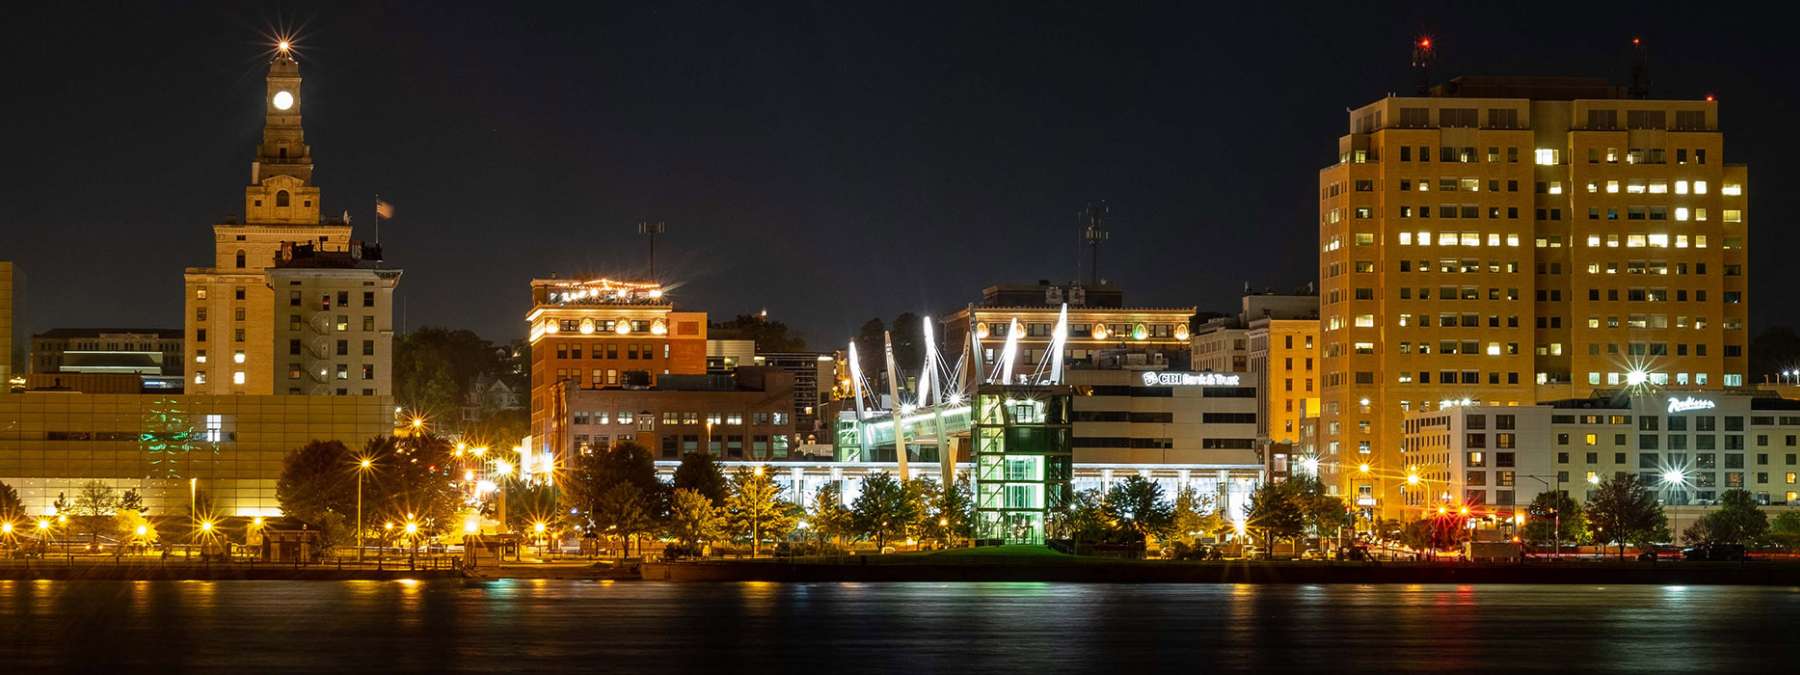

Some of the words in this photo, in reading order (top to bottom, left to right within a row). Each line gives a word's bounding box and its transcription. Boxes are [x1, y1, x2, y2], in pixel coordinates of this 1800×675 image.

[1159, 373, 1182, 385] CBI
[1183, 374, 1204, 385] Bank
[1215, 374, 1239, 385] Trust
